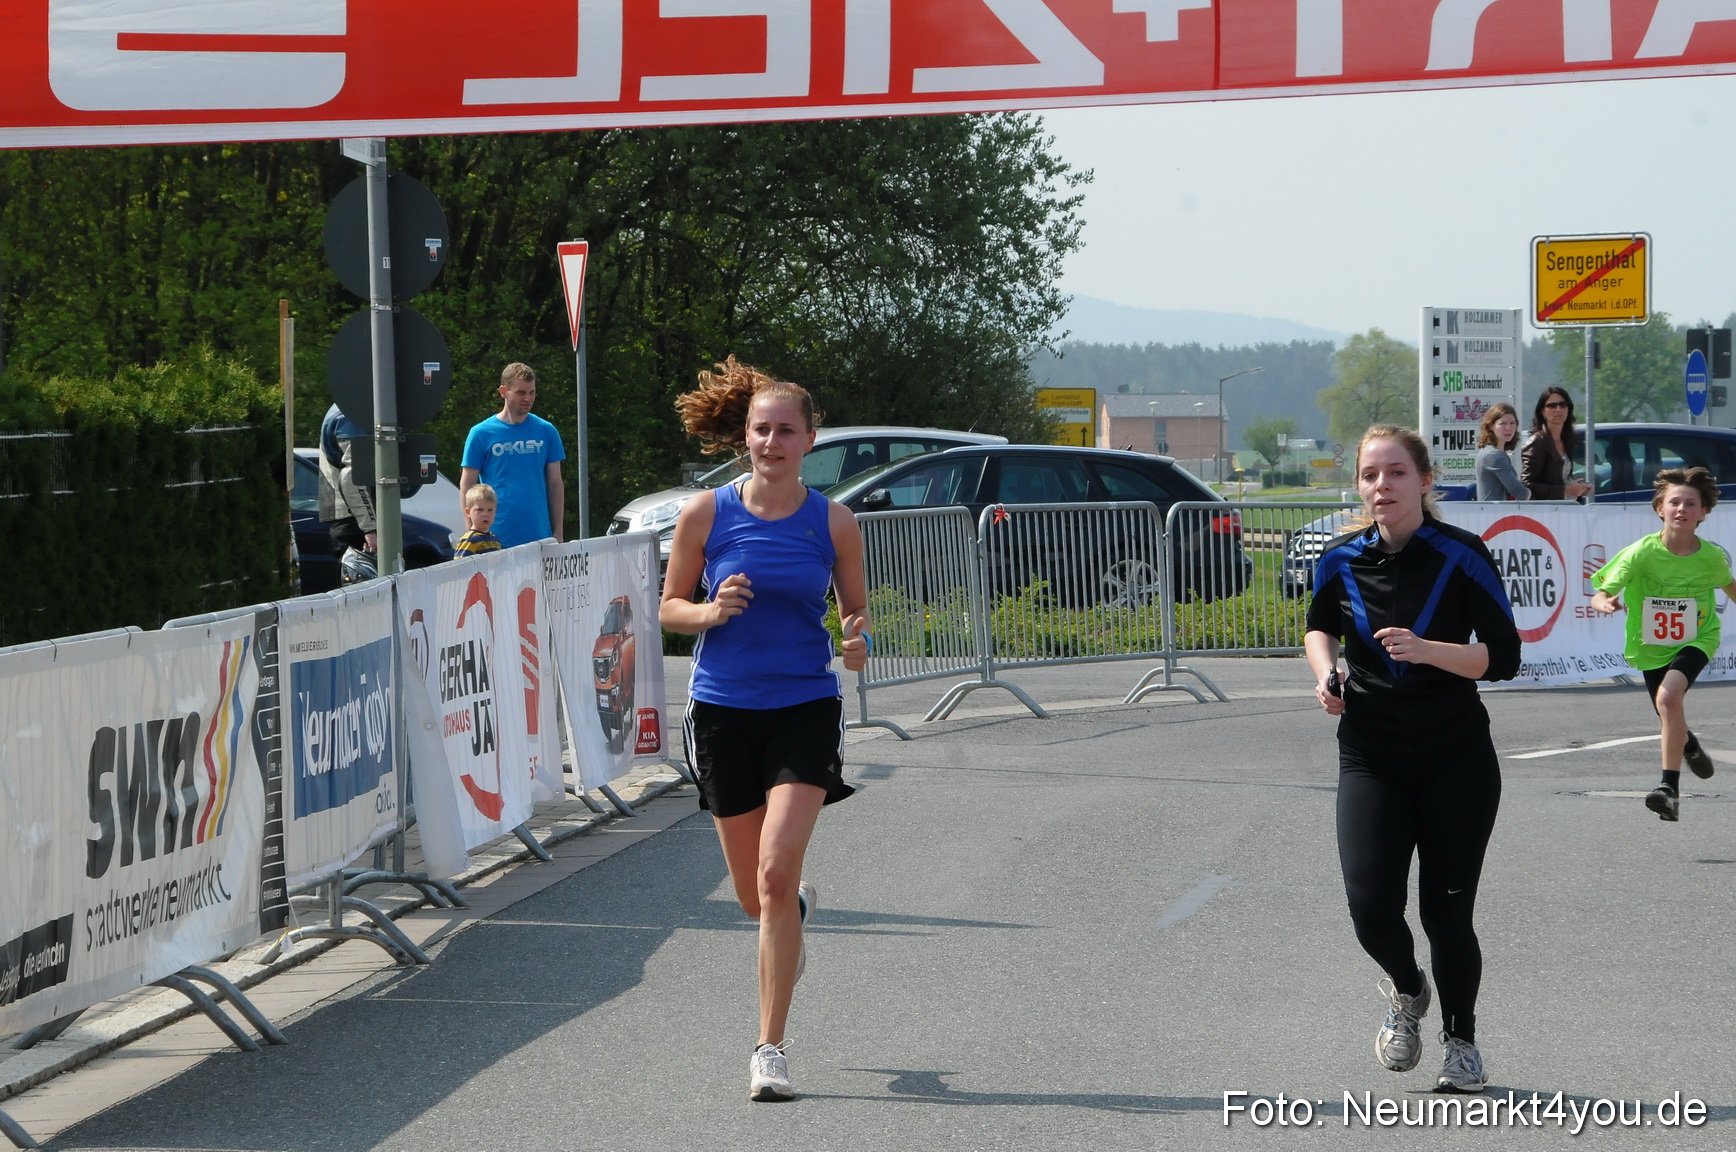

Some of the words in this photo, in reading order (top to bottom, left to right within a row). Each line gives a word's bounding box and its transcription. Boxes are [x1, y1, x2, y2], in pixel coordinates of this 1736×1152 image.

[1546, 249, 1636, 275] Sengenthal
[1558, 279, 1578, 289] am
[1584, 276, 1624, 291] Anger
[1544, 301, 1564, 311] Kreis
[1568, 299, 1607, 311] Neumarkt
[1464, 311, 1503, 324] HOLZAMMER
[1464, 340, 1503, 353] HOLZAMMER
[1443, 371, 1463, 392] SHB
[1464, 374, 1503, 389] Holzfachmarkt
[491, 439, 544, 457] OAKLEY
[1442, 430, 1475, 450] THULE
[1545, 555, 1553, 570] &
[1504, 577, 1556, 608] ÄNIG
[1651, 599, 1677, 607] MEYER
[1653, 612, 1685, 640] 35
[642, 732, 656, 740] KIA
[160, 856, 231, 924] neumarkt
